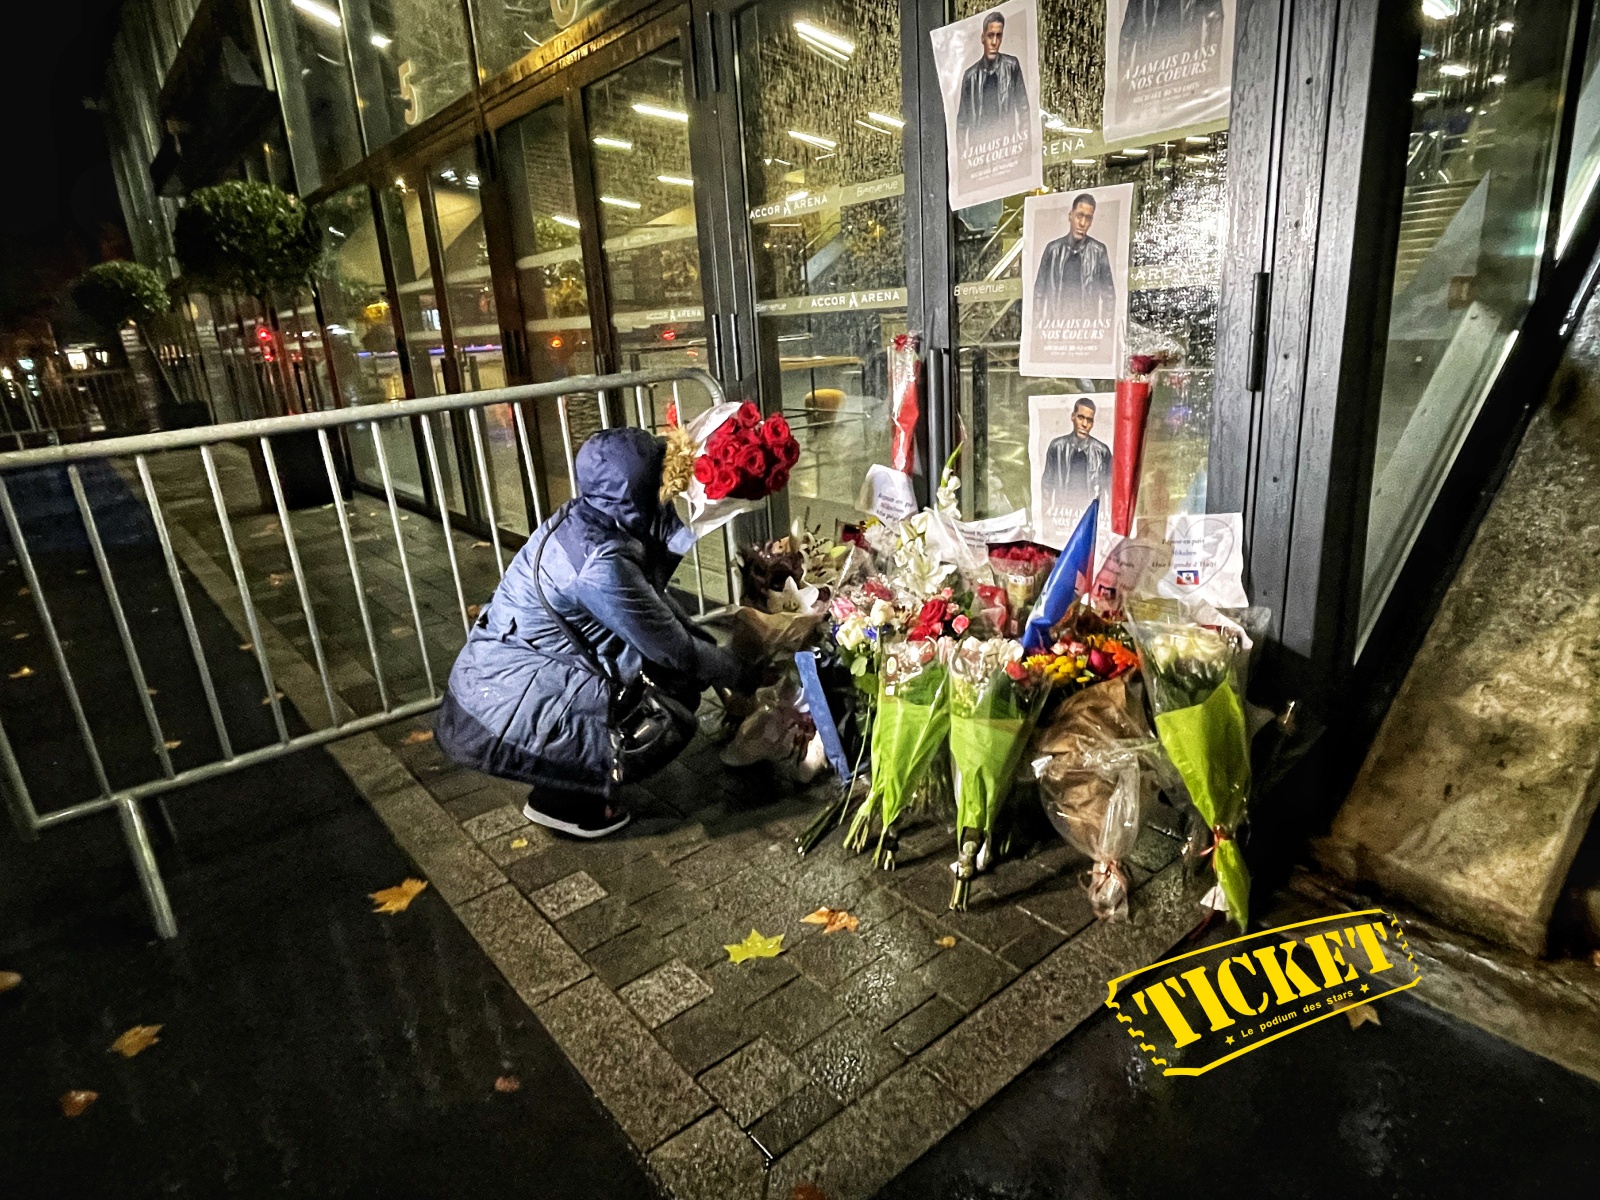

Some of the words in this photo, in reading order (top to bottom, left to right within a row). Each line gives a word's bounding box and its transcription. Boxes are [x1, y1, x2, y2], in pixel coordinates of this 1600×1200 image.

[1132, 54, 1179, 77] JAMAIS
[1181, 43, 1218, 64] DANS
[1128, 75, 1154, 92] NOS
[1156, 60, 1208, 84] COEURS
[968, 138, 1001, 158] JAMAIS
[1003, 129, 1029, 147] DANS
[1042, 137, 1085, 156] RENA
[967, 154, 985, 169] NOS
[986, 142, 1024, 163] COEURS
[749, 204, 780, 219] ACCOR
[793, 195, 828, 211] ARENA
[811, 295, 846, 308] ACCOR
[861, 290, 900, 304] ARENA
[953, 283, 1005, 296] Bienvenue
[1043, 318, 1082, 329] JAMAIS
[1083, 318, 1111, 329] DANS
[1041, 329, 1061, 340] NOS
[1062, 329, 1105, 340] COEURS
